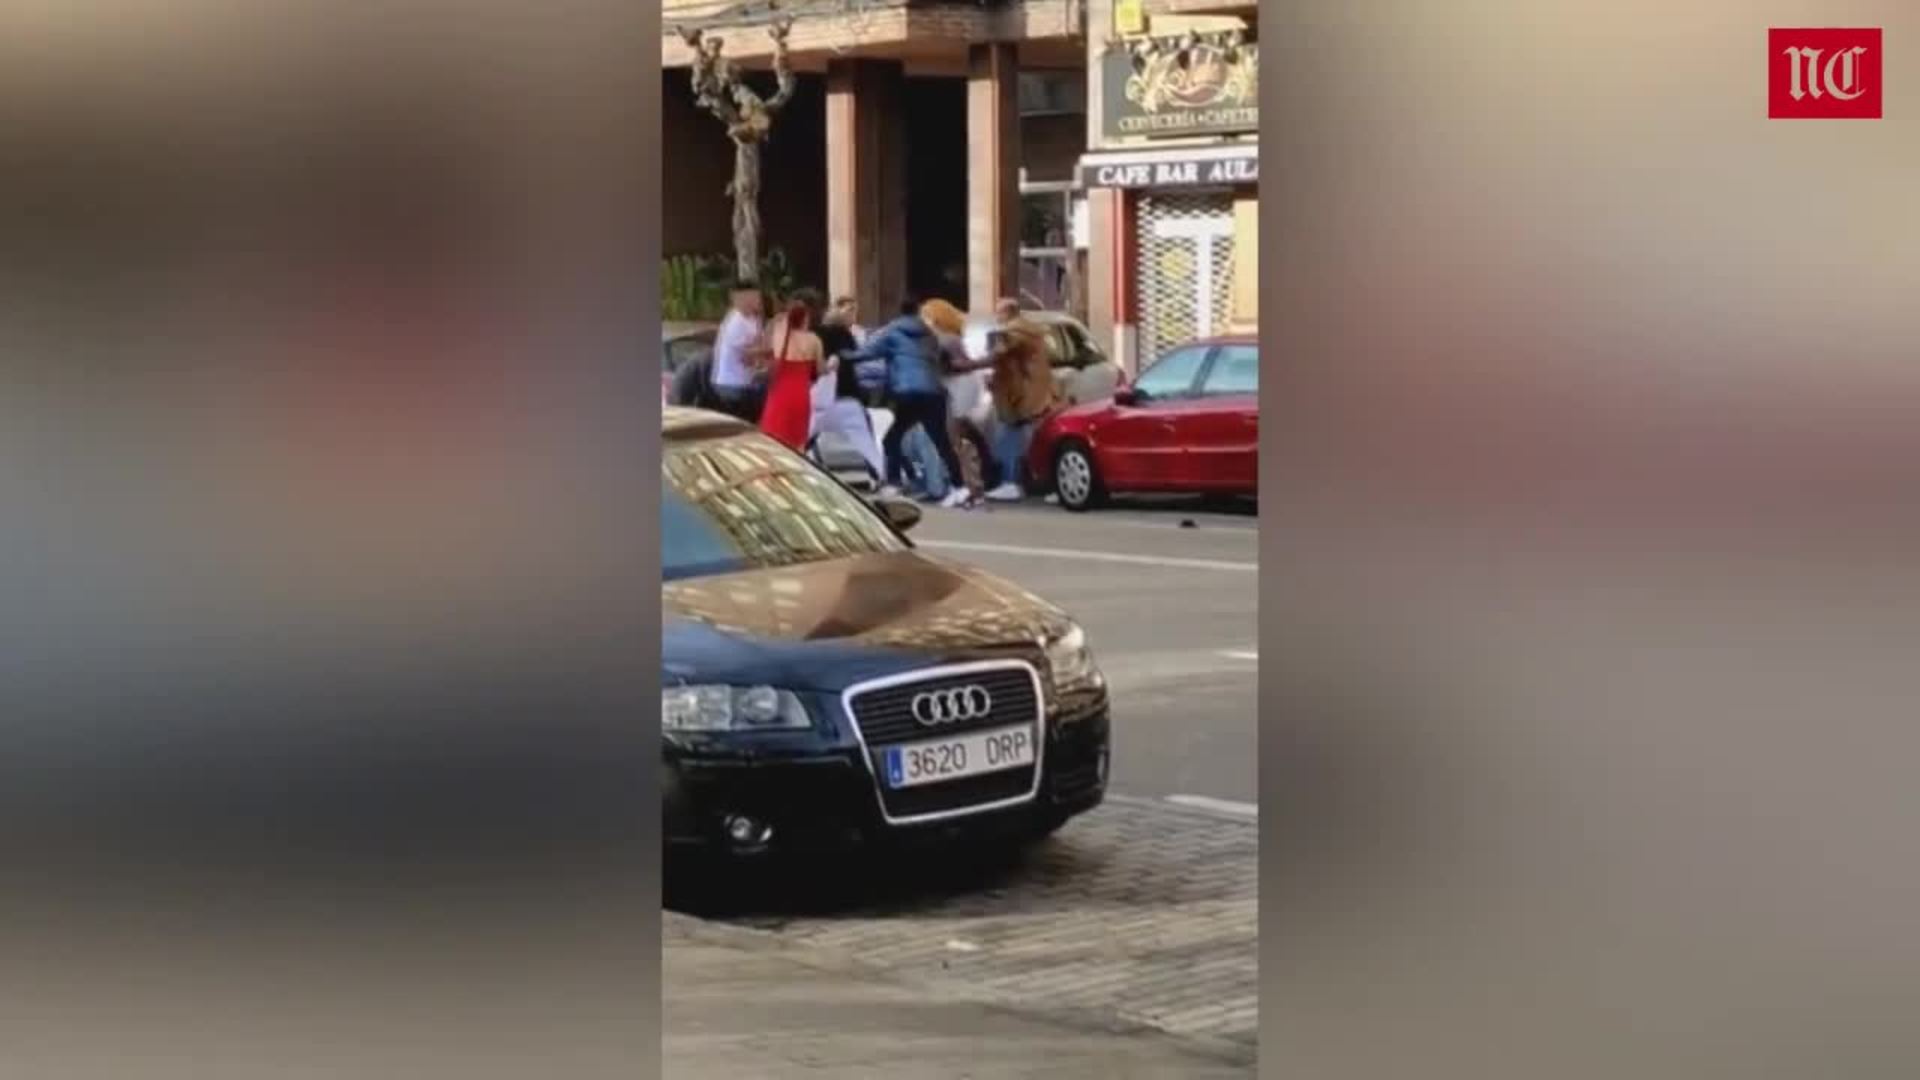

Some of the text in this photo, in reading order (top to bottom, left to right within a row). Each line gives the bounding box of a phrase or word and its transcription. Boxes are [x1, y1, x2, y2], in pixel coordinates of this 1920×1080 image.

[1098, 165, 1150, 185] CAFE
[1155, 162, 1198, 184] BAR
[908, 731, 1027, 779] 3620 DRP
